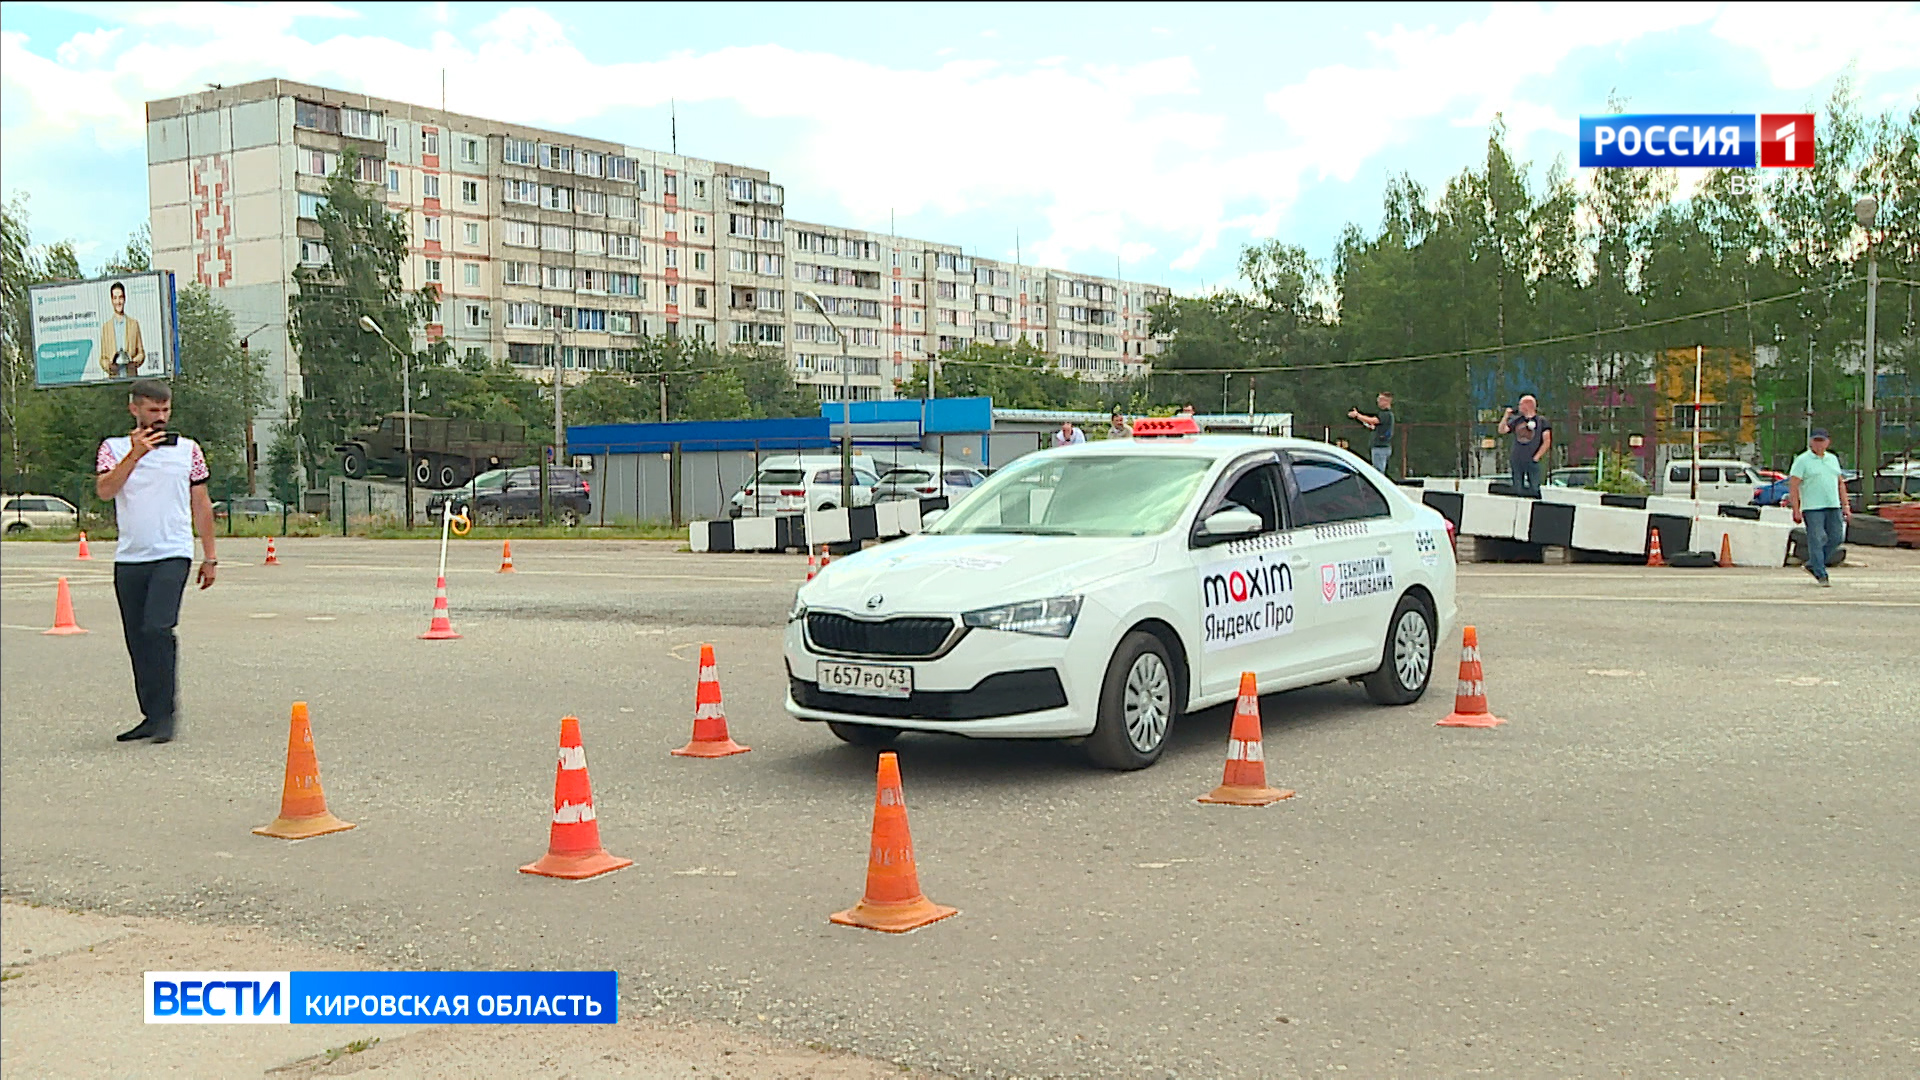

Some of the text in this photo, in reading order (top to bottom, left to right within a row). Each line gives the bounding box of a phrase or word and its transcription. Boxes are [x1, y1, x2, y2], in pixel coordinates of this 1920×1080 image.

[1203, 555, 1293, 608] maxim
[1338, 557, 1386, 580] ТЕХНОЛОГИИ
[1340, 575, 1394, 600] СТРАХОВАНИЯ
[1205, 601, 1294, 642] Яндекс Про
